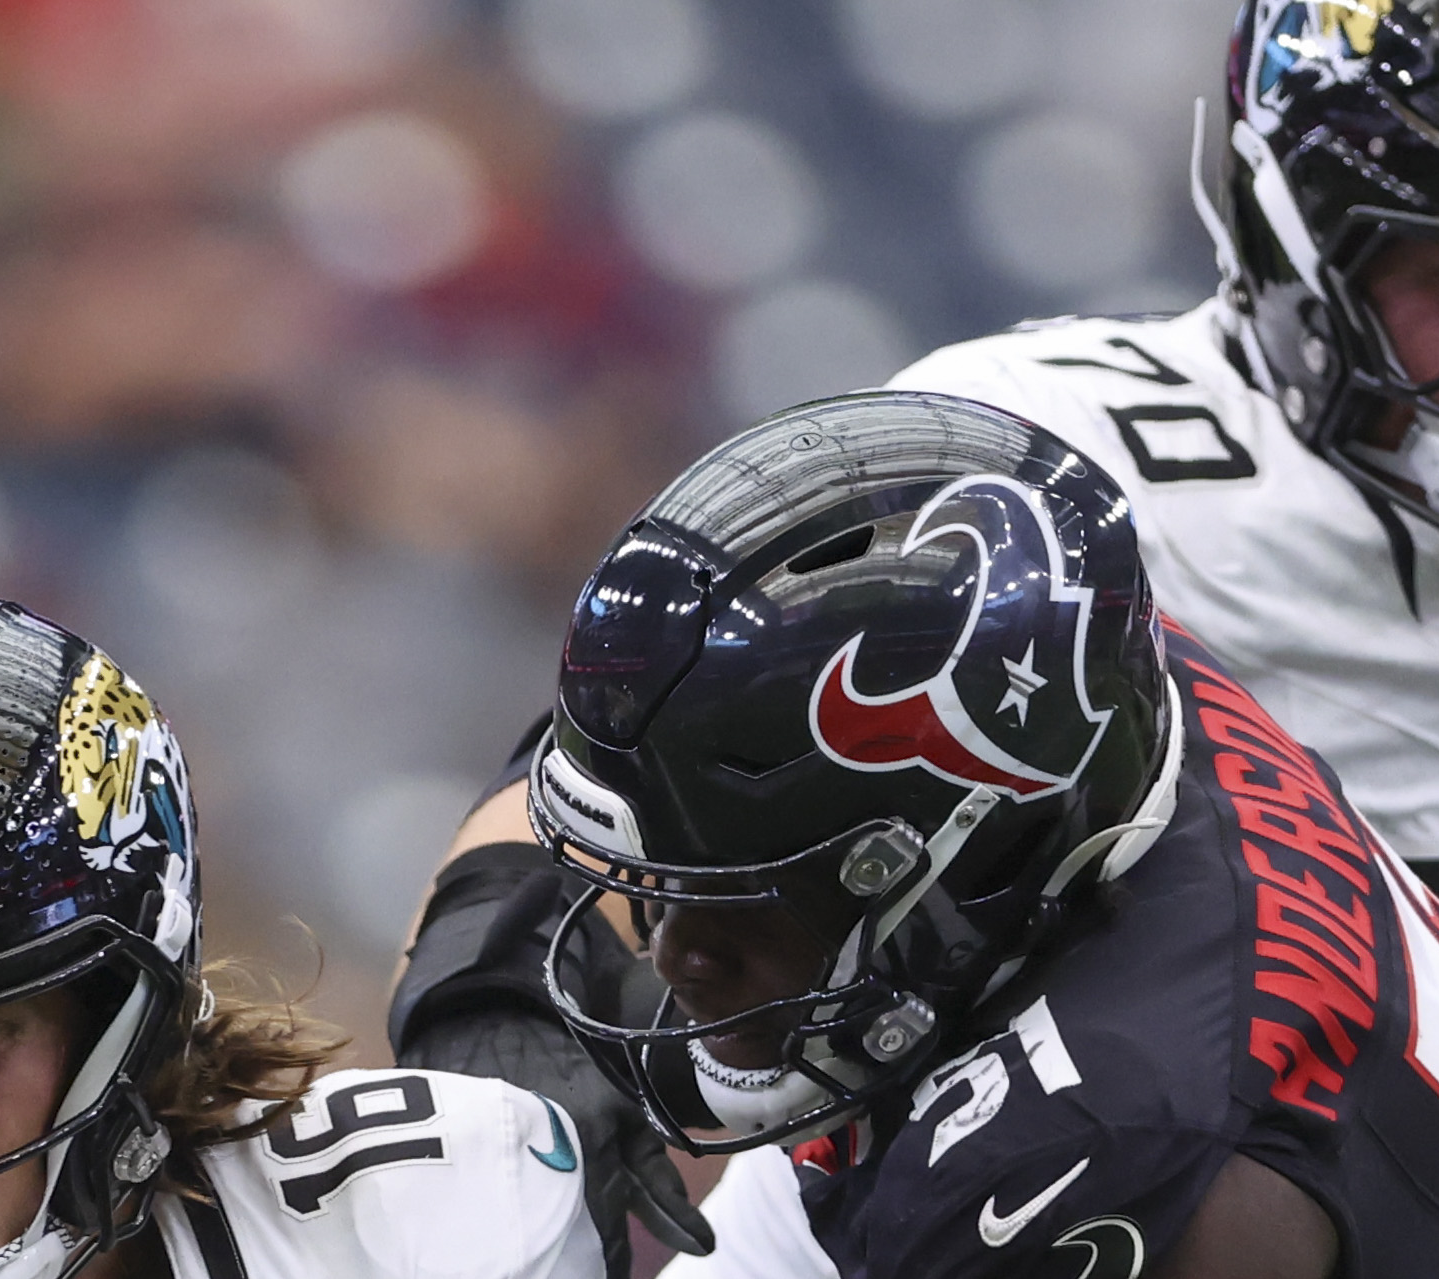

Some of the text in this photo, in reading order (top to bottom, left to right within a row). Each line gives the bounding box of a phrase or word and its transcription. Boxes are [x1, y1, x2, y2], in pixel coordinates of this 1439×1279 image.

[1035, 337, 1258, 483] 70
[262, 1075, 445, 1215] 16
[909, 994, 1083, 1168] 51
